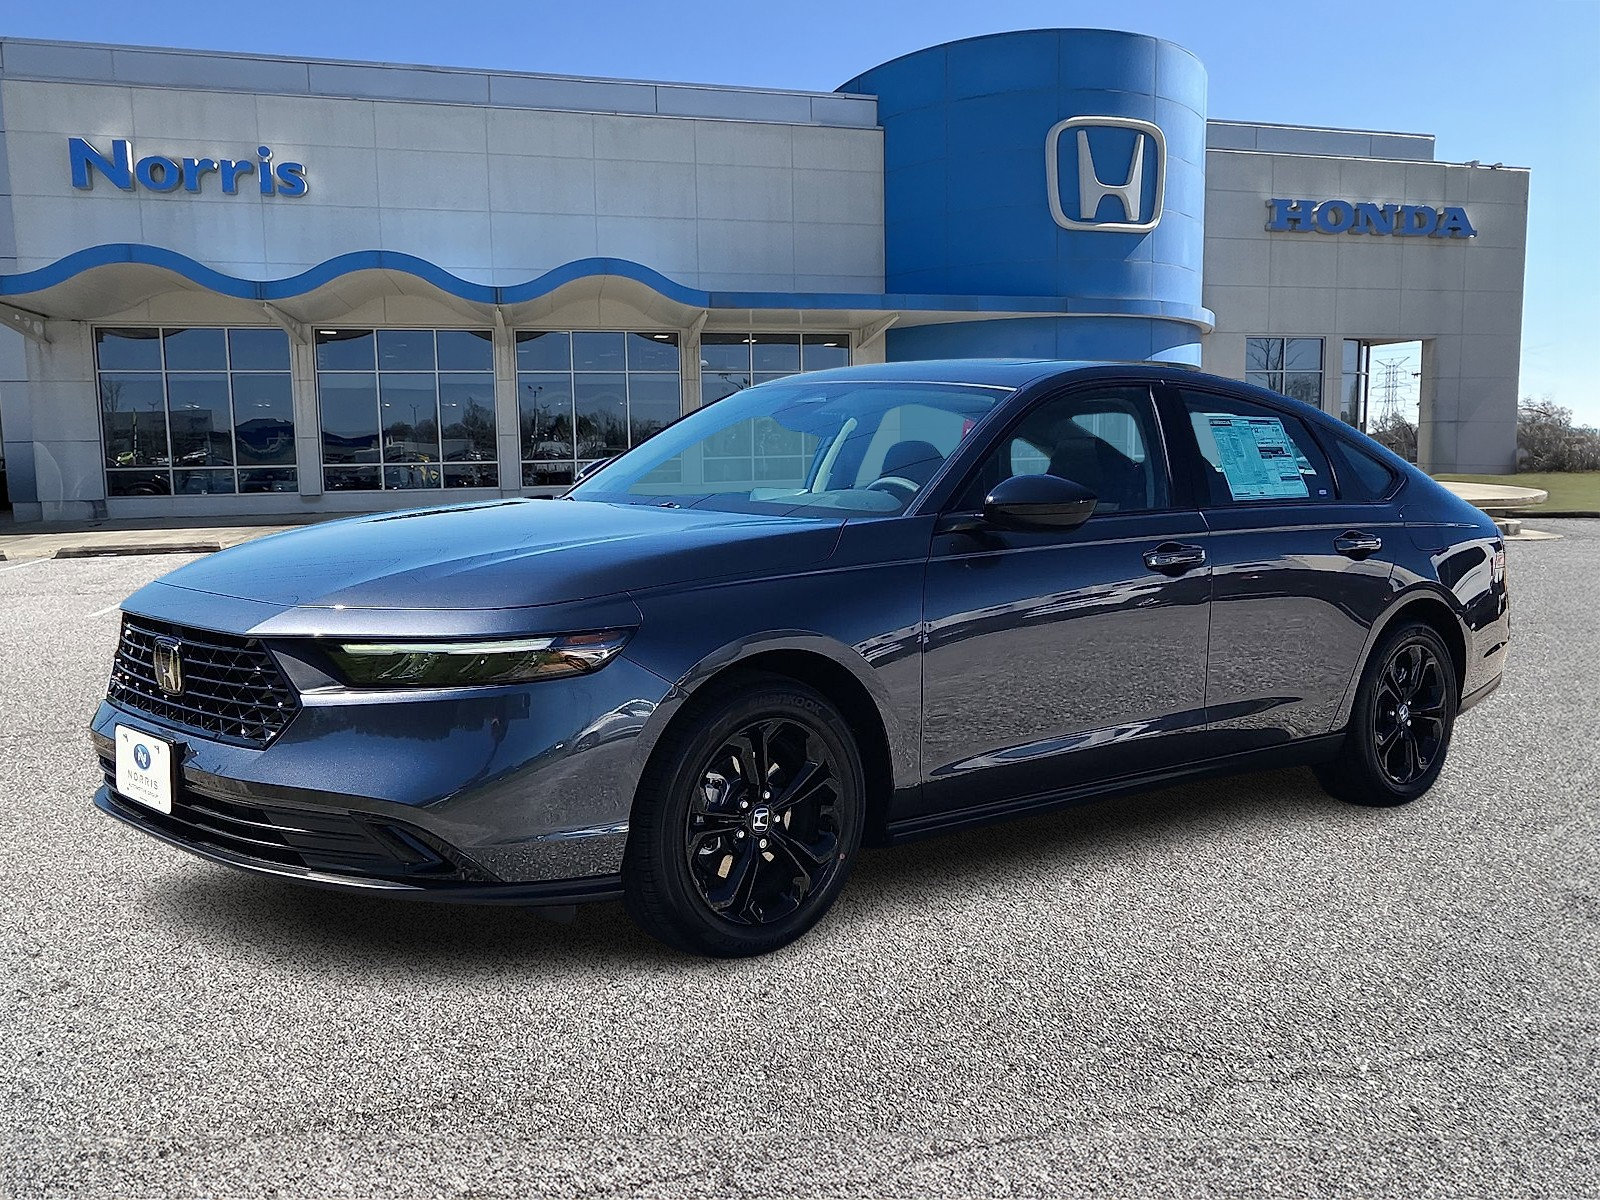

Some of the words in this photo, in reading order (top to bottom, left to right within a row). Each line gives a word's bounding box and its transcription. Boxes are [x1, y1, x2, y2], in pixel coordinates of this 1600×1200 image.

[68, 137, 308, 197] Norris
[1266, 198, 1478, 238] HONDA
[127, 769, 158, 790] NORRIS
